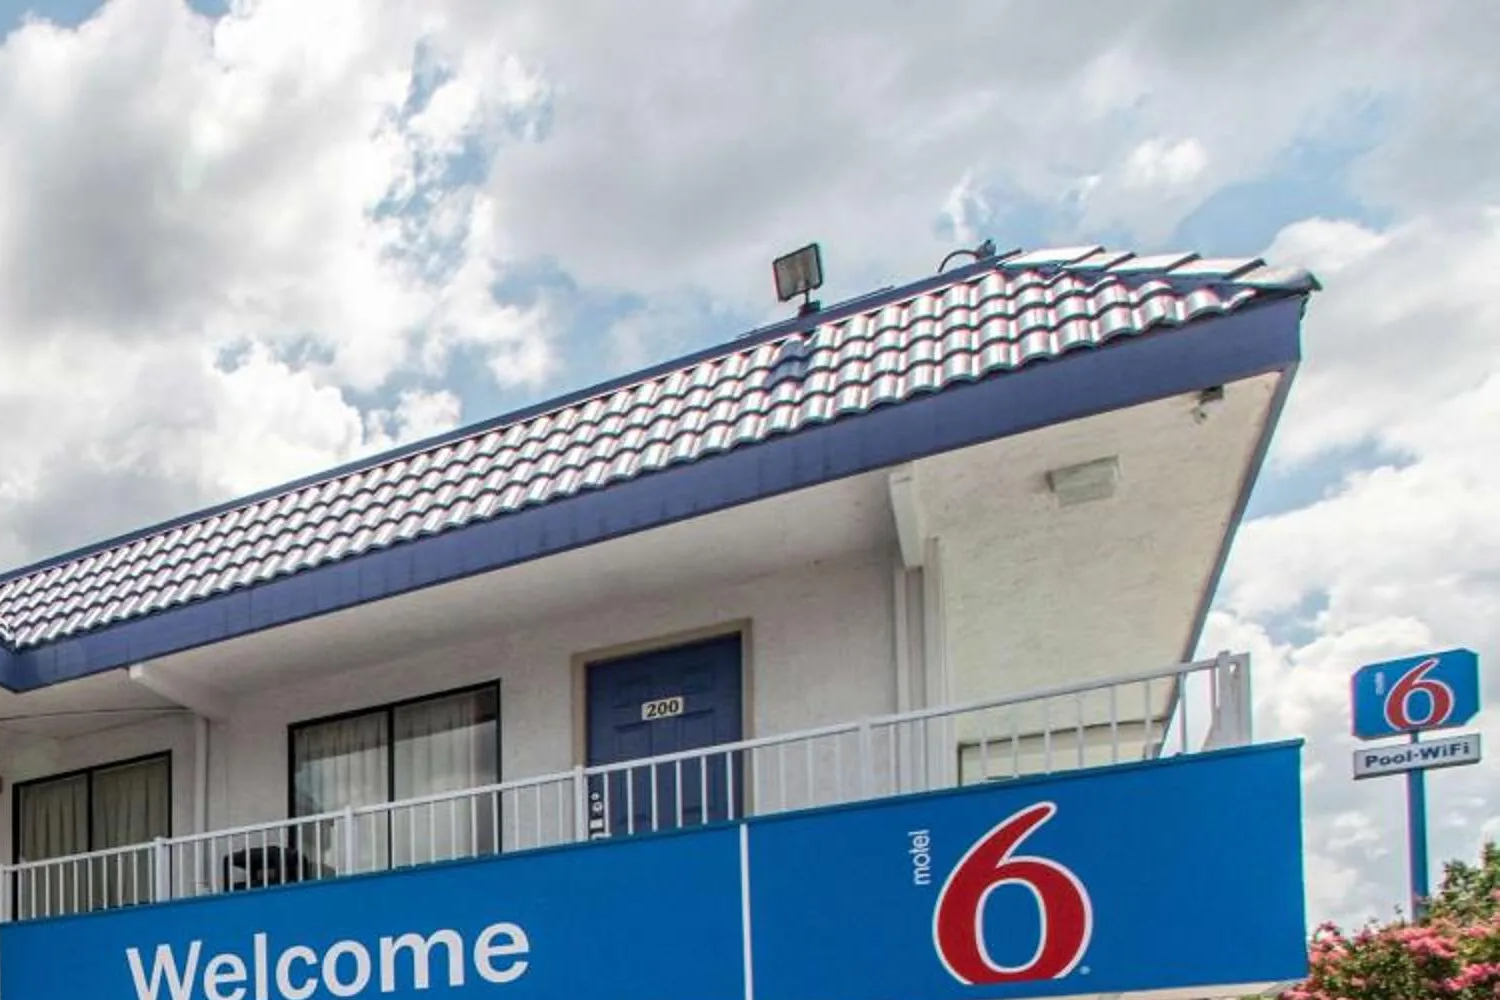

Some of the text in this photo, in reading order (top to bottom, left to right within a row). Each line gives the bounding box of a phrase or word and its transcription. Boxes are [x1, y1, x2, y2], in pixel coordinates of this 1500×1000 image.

[647, 700, 679, 717] 200
[1384, 658, 1454, 731] 6
[908, 801, 1093, 985] motel 6
